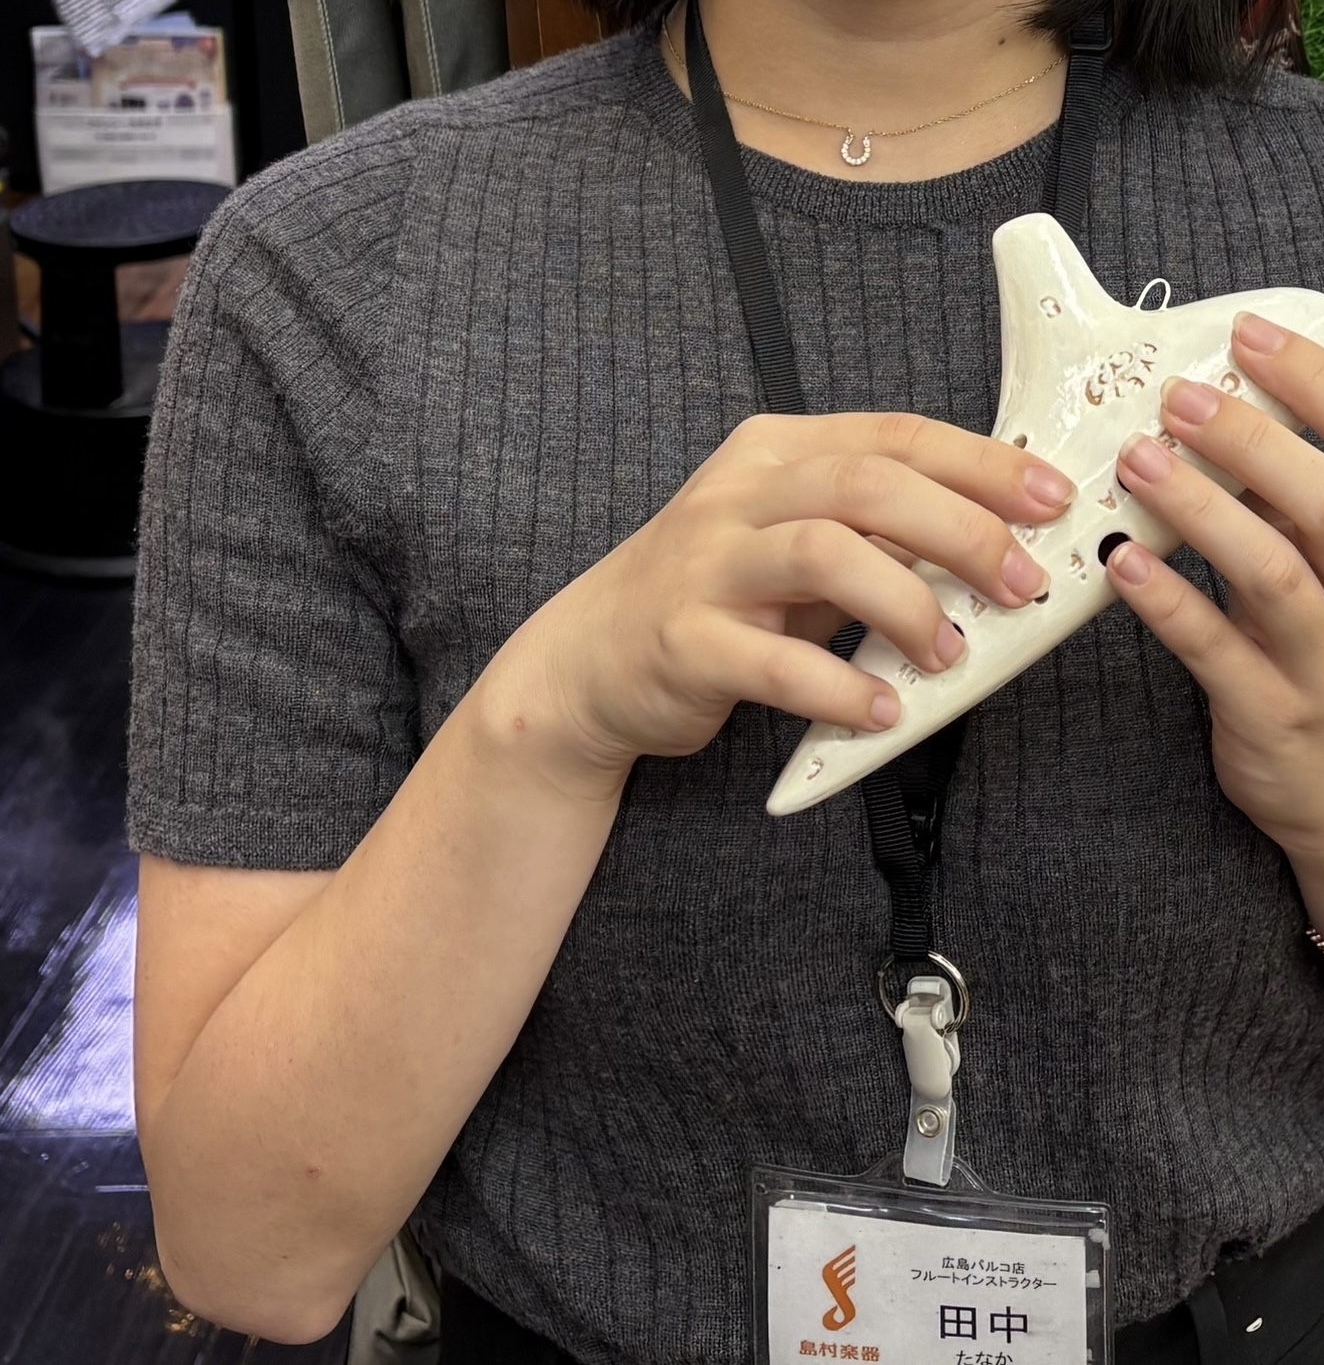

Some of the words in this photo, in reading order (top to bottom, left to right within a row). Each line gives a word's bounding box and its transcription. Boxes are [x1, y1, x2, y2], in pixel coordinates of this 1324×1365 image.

[941, 1256, 1026, 1276] 広島パルコ店
[910, 1268, 1057, 1289] フルートインストラクター
[939, 1304, 1029, 1344] 田中
[798, 1340, 880, 1362] 島村楽器
[955, 1350, 1014, 1365] たなか
